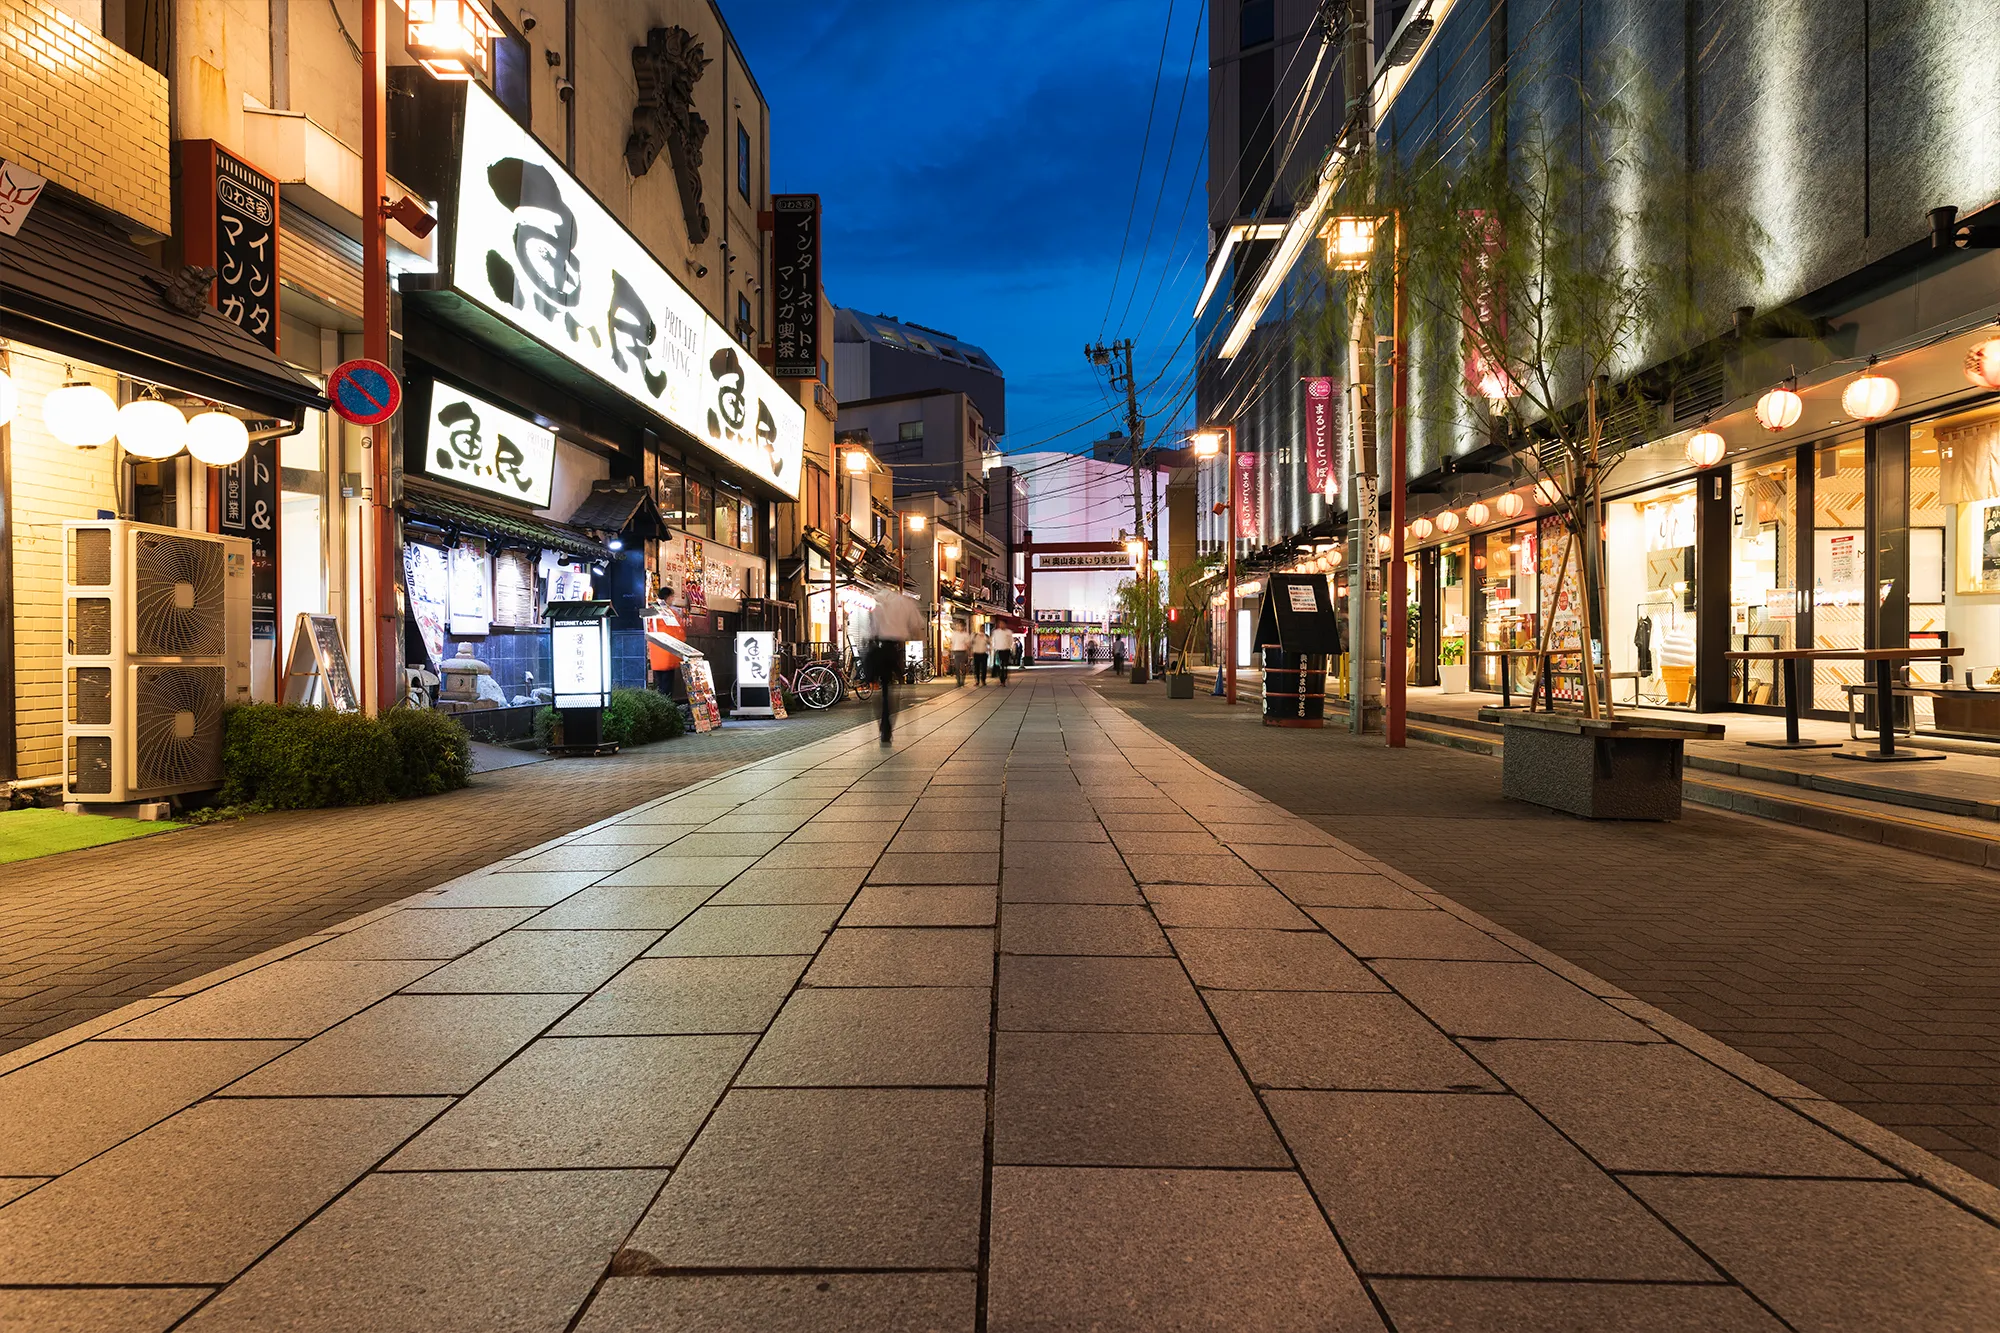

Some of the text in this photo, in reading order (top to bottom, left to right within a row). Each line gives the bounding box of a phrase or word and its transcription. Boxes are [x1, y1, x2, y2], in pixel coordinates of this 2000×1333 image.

[221, 182, 268, 221] いわき家
[779, 200, 812, 209] いわき家
[249, 232, 270, 335] インタ
[486, 157, 667, 399] 魚民
[778, 265, 795, 358] マンガ喫茶
[797, 215, 813, 359] インターネット&
[664, 306, 697, 355] PRIVATE
[436, 401, 532, 492] 魚民
[707, 347, 783, 477] 魚民
[1315, 404, 1329, 489] まるごとにっぽん
[743, 637, 768, 680] 魚民
